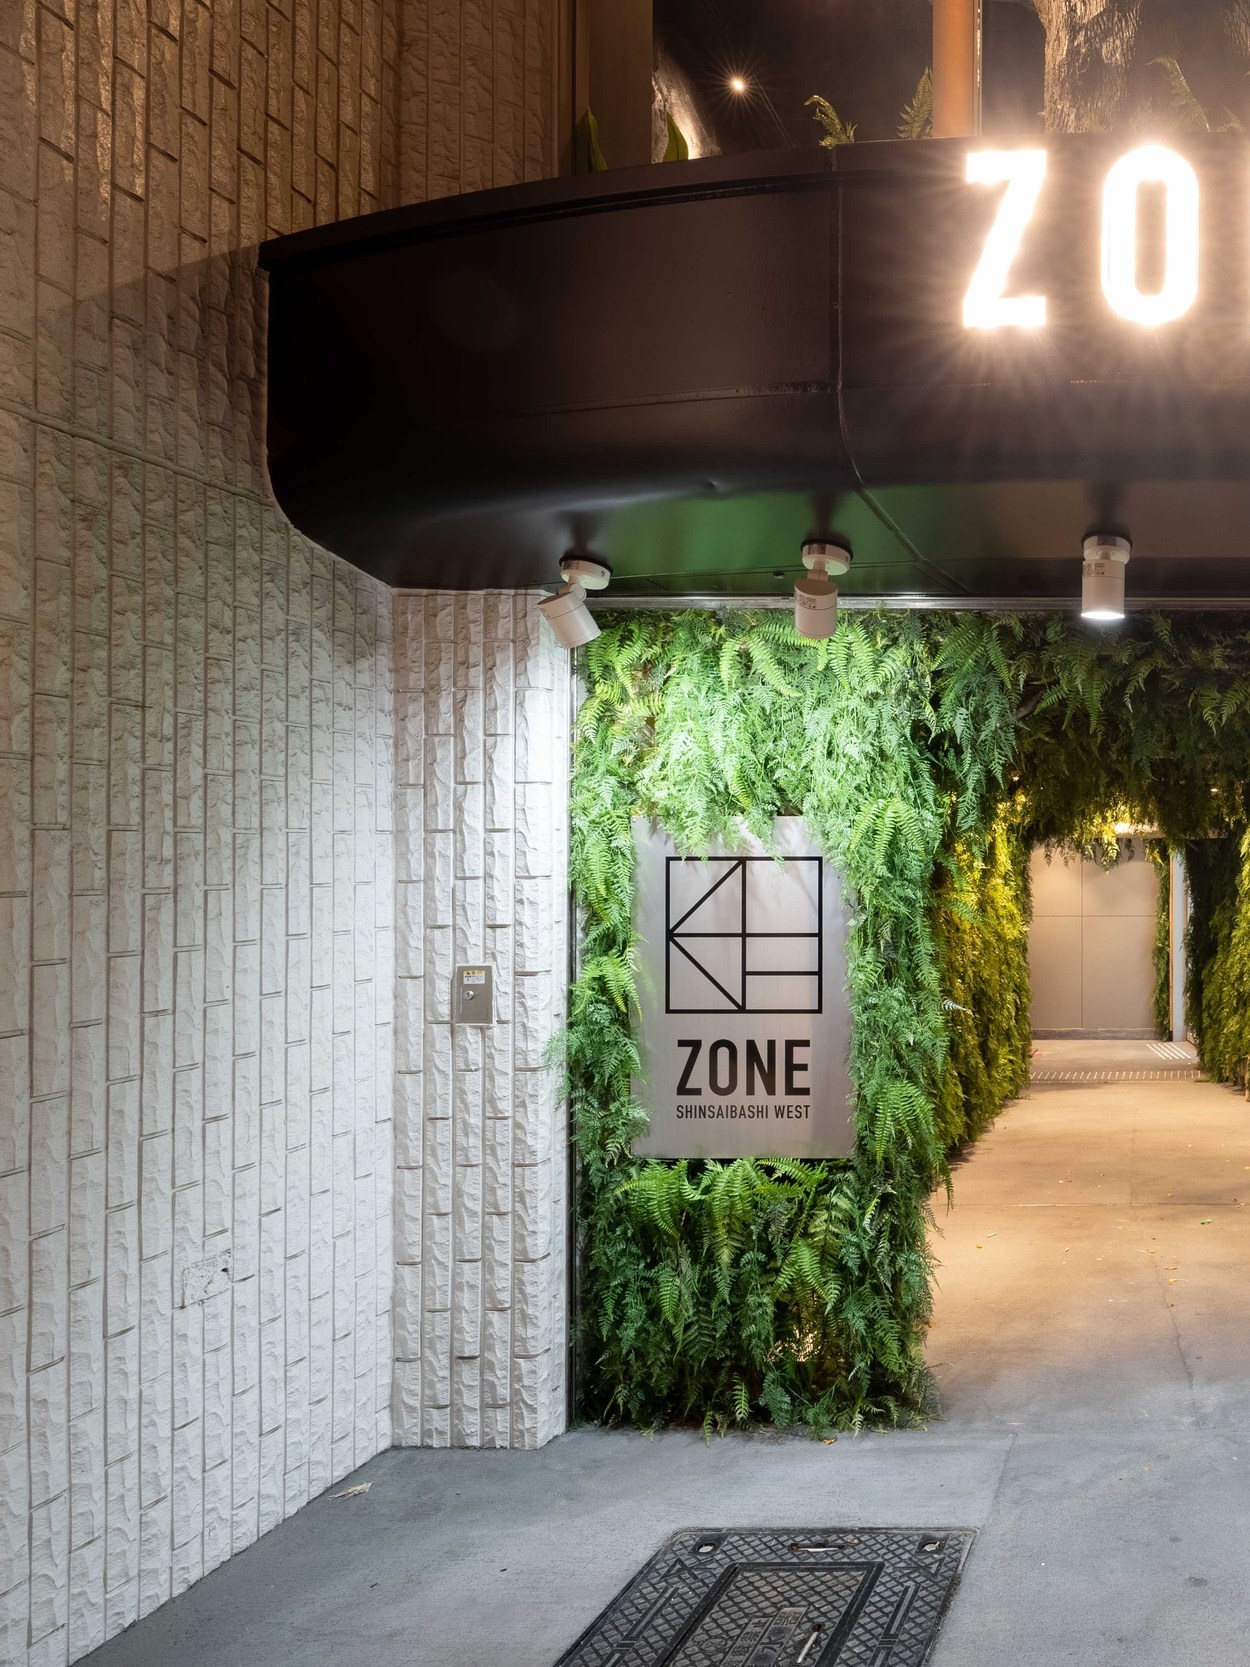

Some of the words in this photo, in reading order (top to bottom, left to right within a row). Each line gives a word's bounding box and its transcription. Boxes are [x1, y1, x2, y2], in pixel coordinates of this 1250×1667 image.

[676, 1039, 811, 1096] ZONE
[676, 1104, 769, 1119] SHINSAIBASHI
[774, 1104, 811, 1119] WEST
